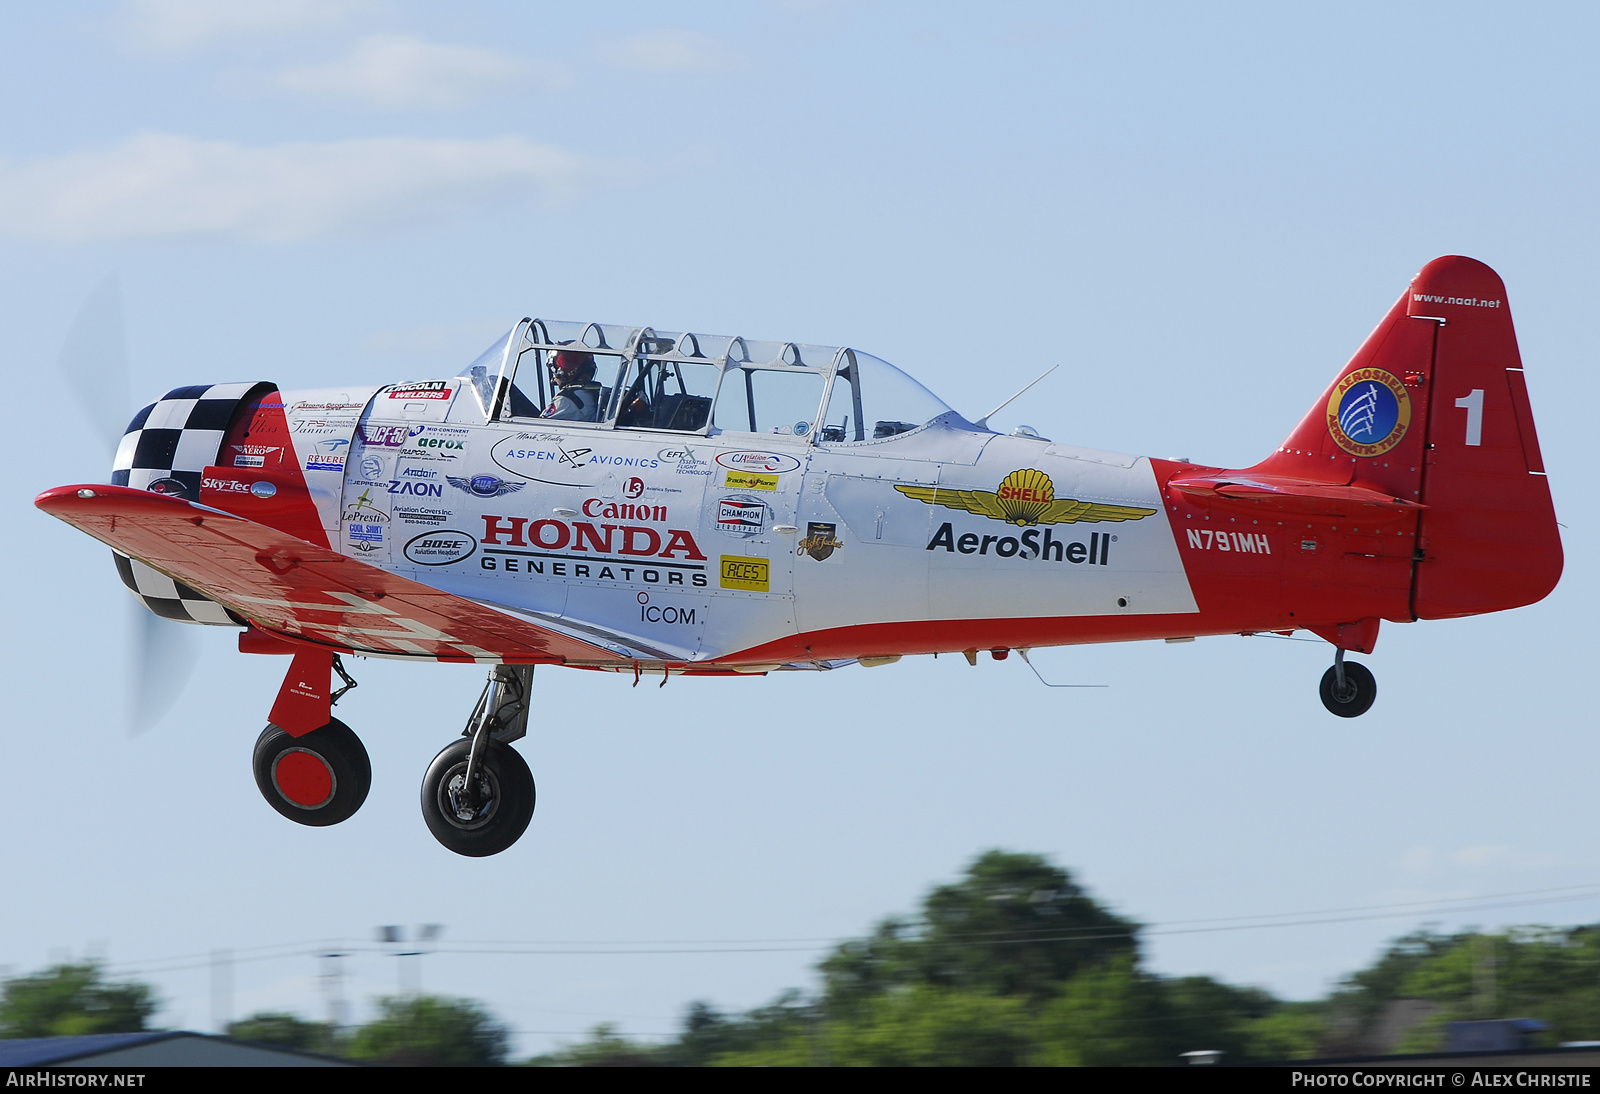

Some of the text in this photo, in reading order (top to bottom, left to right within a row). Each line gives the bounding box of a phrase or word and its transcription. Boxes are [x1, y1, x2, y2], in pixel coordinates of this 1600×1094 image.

[1413, 293, 1501, 309] www.naat.net
[388, 382, 443, 392] LINCOLN
[1338, 368, 1407, 404] AEROSHELL
[395, 391, 445, 399] WELDERS
[1454, 388, 1485, 446] 1
[1328, 413, 1406, 456] AEROBATIC TEAM
[417, 437, 465, 450] aerox
[241, 447, 266, 455] AERO
[307, 454, 345, 464] REVERE
[506, 449, 659, 469] ASPEN AVIONICS
[402, 467, 438, 479] Andair
[675, 468, 713, 476] TECHNOLOGY
[201, 478, 250, 492] Sky-Tec
[352, 480, 389, 488] JEPPESEN
[999, 485, 1051, 504] SHELL
[393, 505, 419, 513] Aviation
[420, 507, 441, 515] Covers
[582, 498, 668, 522] Canon
[721, 508, 761, 520] CHAMPION
[350, 523, 364, 533] COOL
[716, 523, 764, 534] AEROSPACE
[415, 540, 468, 549] BOSE
[480, 514, 708, 562] HONDA
[926, 522, 1110, 566] AeroShell
[1186, 528, 1272, 556] N791MH
[438, 549, 460, 557] Headset
[480, 556, 708, 588] GENERATORS
[727, 563, 760, 579] ACES
